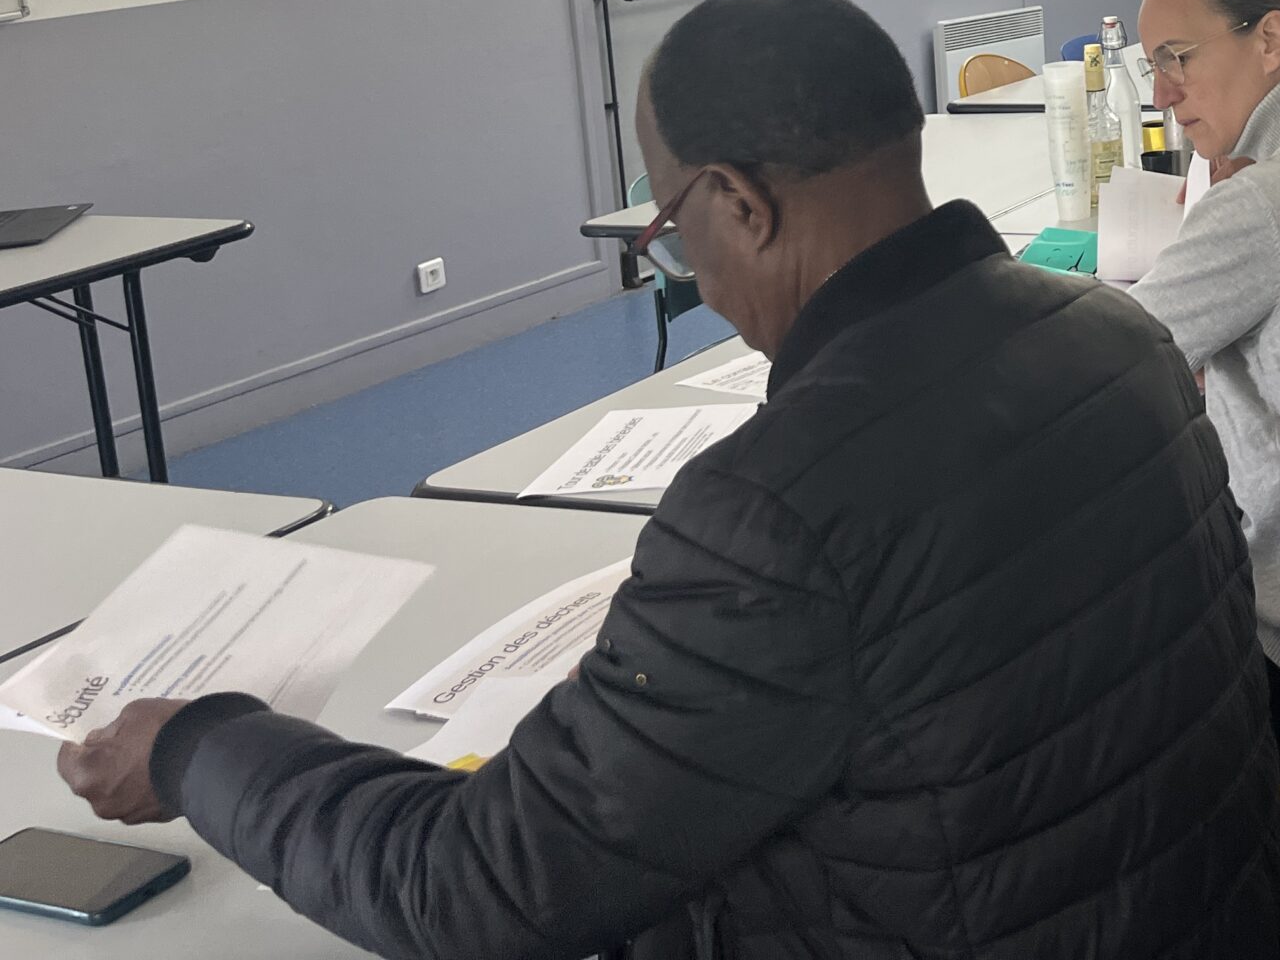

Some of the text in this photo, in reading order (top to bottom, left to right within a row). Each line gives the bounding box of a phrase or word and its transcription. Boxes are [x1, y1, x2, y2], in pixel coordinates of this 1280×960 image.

[434, 655, 506, 705] Gestion
[503, 631, 538, 653] des
[536, 592, 602, 630] déchets
[46, 676, 110, 728] Sécurité
